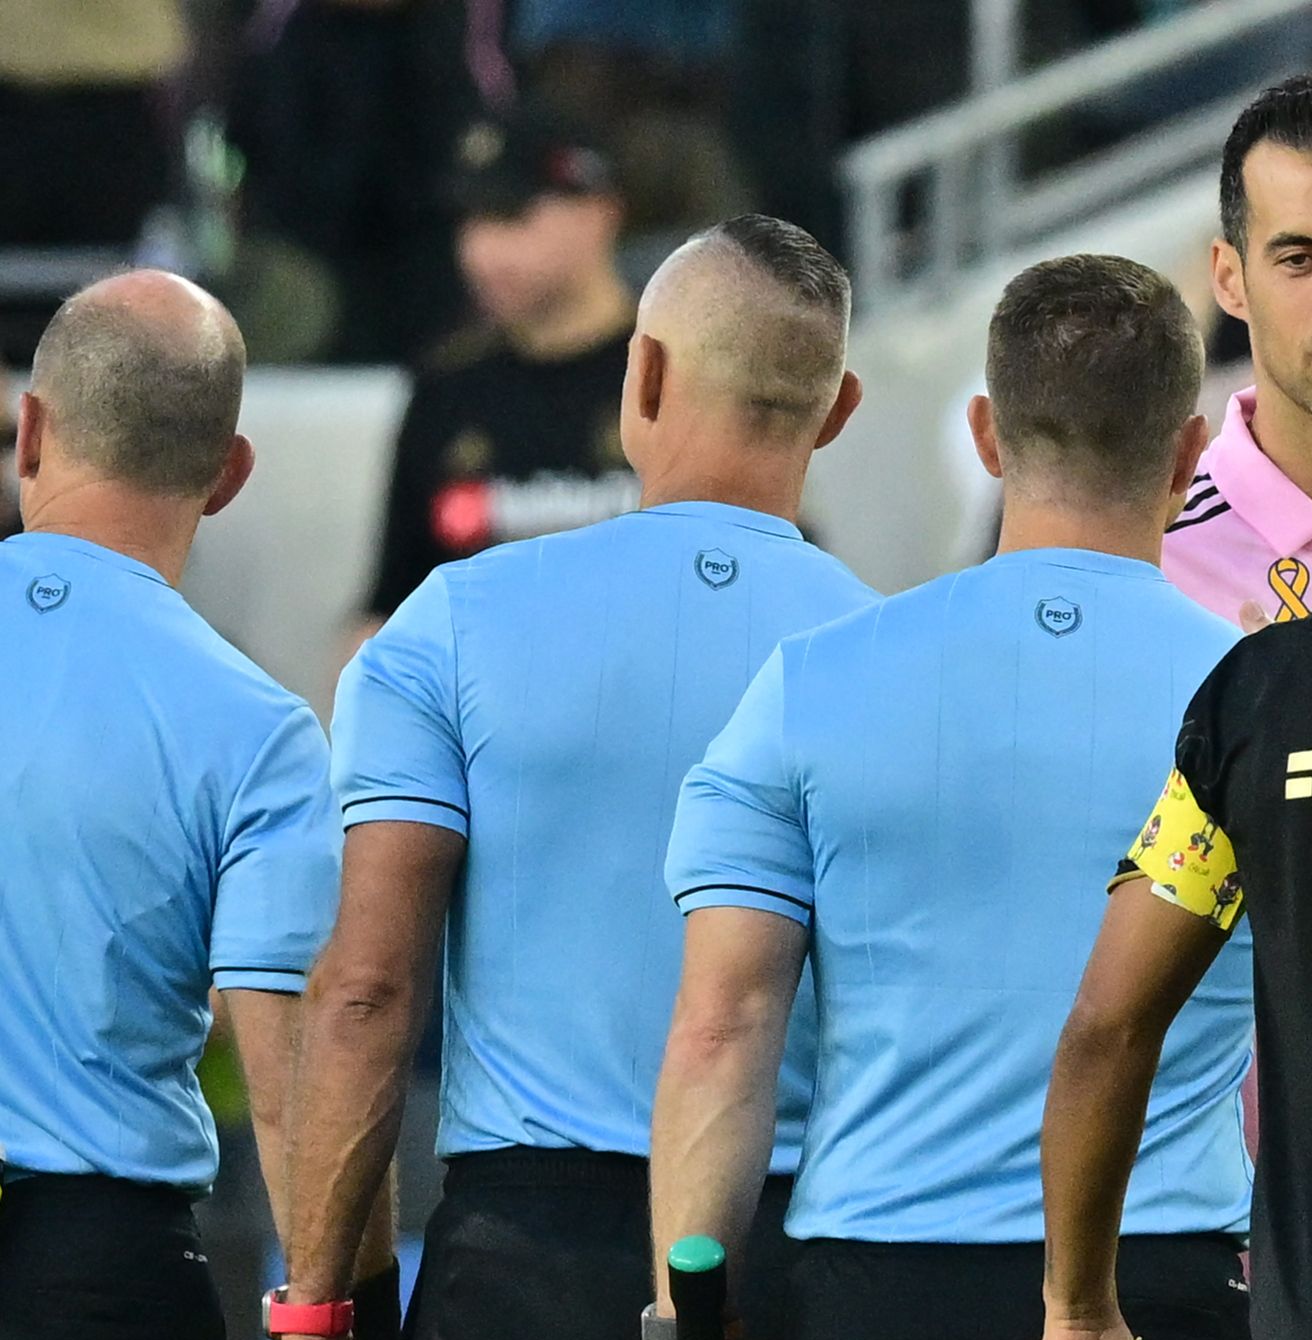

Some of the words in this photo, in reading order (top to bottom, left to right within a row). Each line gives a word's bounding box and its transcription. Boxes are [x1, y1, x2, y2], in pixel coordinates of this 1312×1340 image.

[705, 560, 730, 573] PRO
[36, 586, 61, 597] PRO
[1046, 609, 1073, 621] PRO
